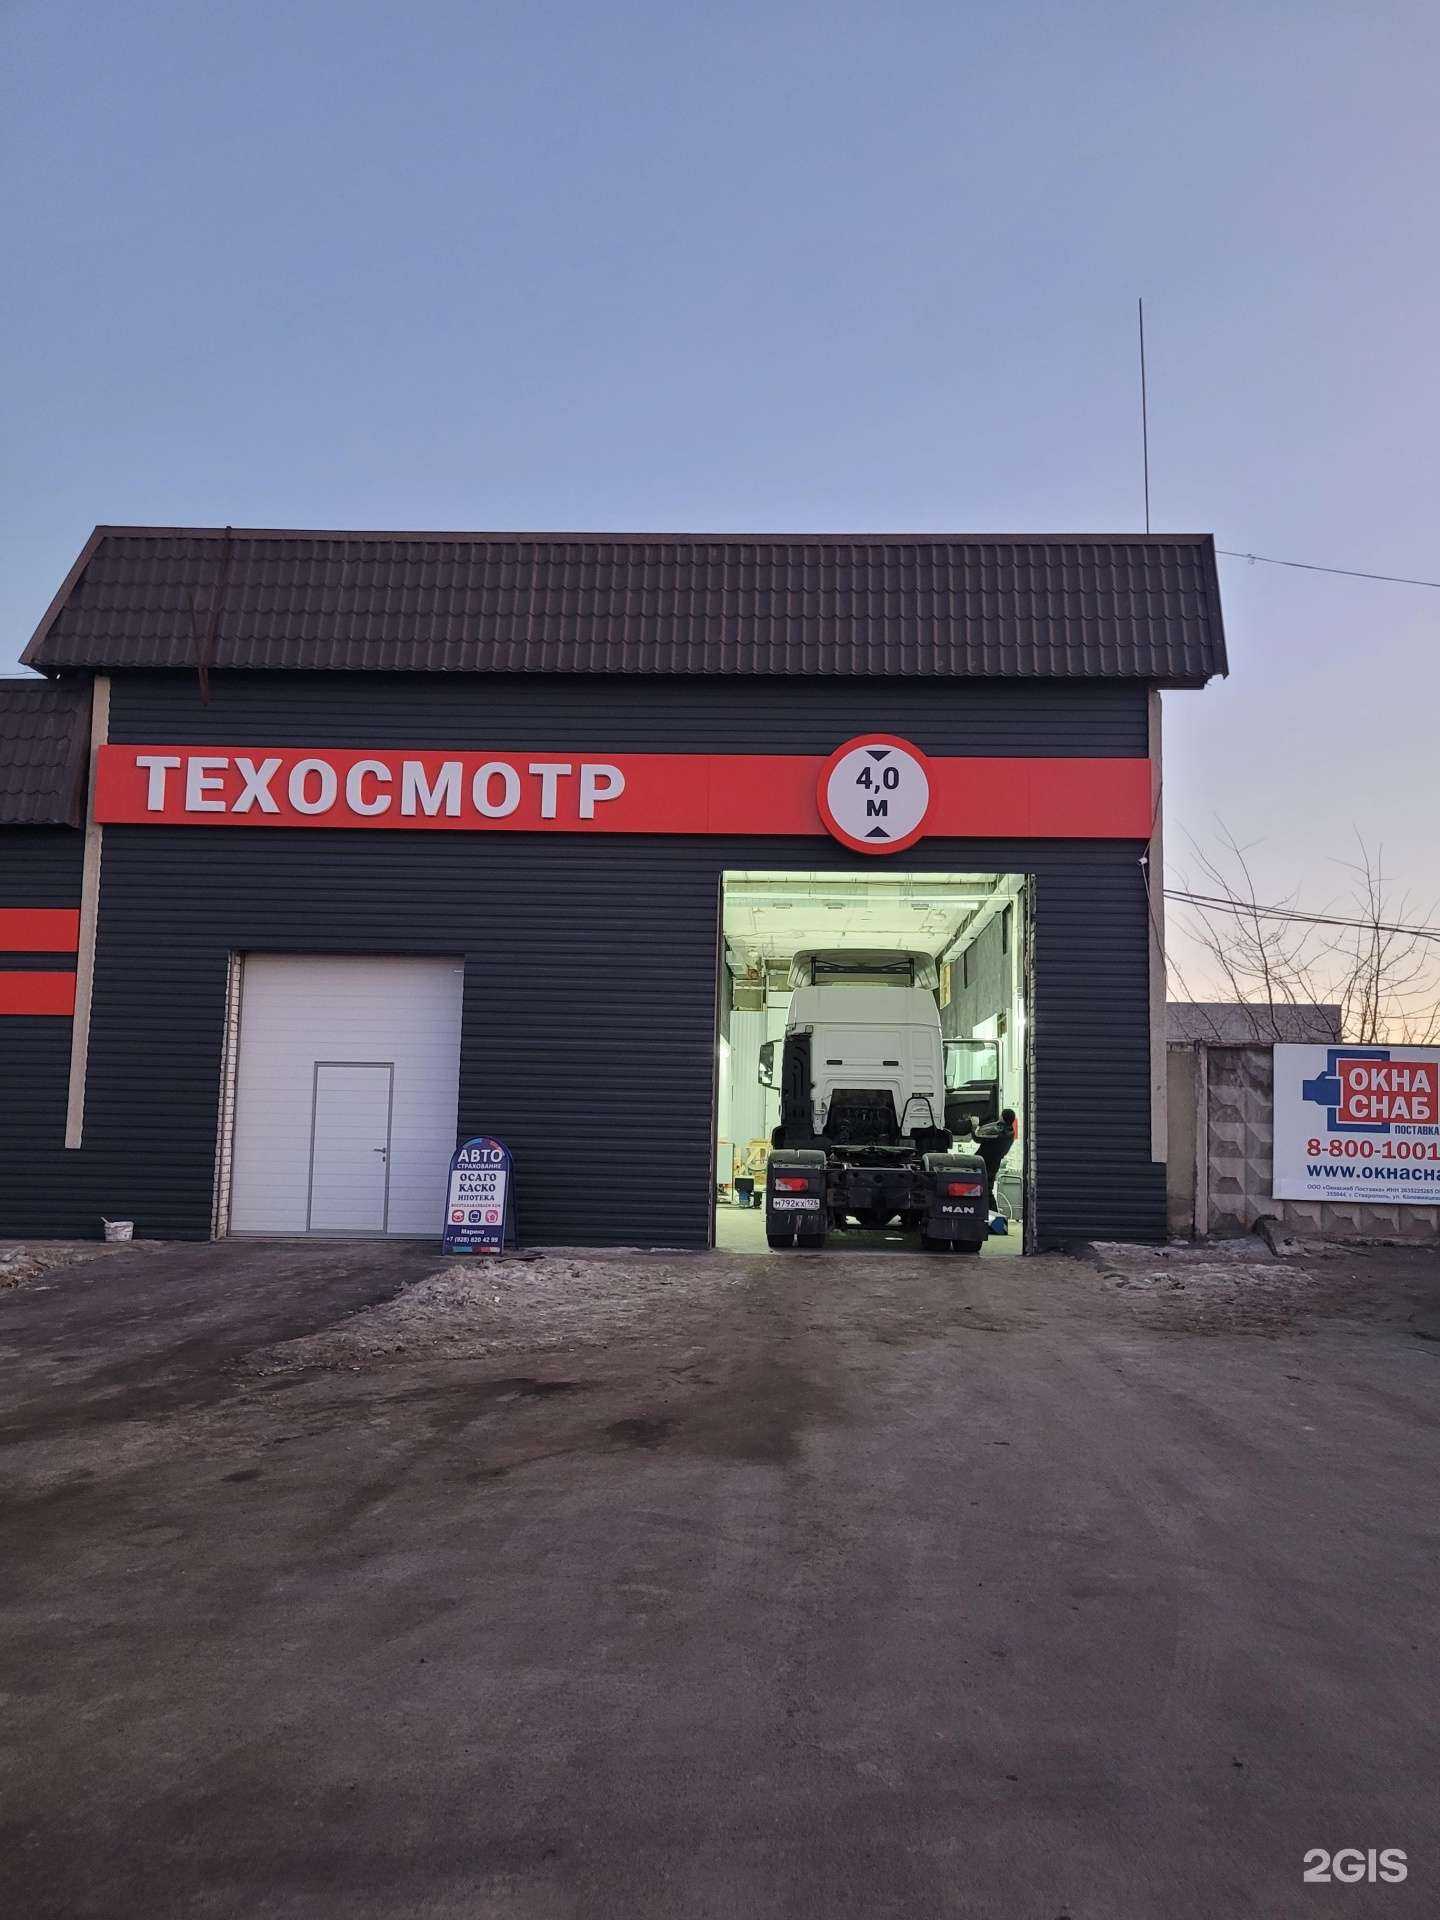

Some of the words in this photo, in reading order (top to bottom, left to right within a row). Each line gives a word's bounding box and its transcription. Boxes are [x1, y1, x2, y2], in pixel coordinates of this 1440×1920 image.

[136, 755, 626, 819] ТЕХОСМОТР
[856, 767, 900, 794] 4,0
[1349, 1067, 1431, 1093] ОКНА
[1349, 1094, 1431, 1120] СНАБ
[1394, 1125, 1440, 1136] ПОСТАВКА
[457, 1149, 503, 1163] АВТО
[1306, 1138, 1440, 1161] 8-800-1001
[459, 1173, 497, 1181] ОСАГО
[459, 1183, 496, 1192] КАСКО
[942, 1205, 975, 1214] MAN
